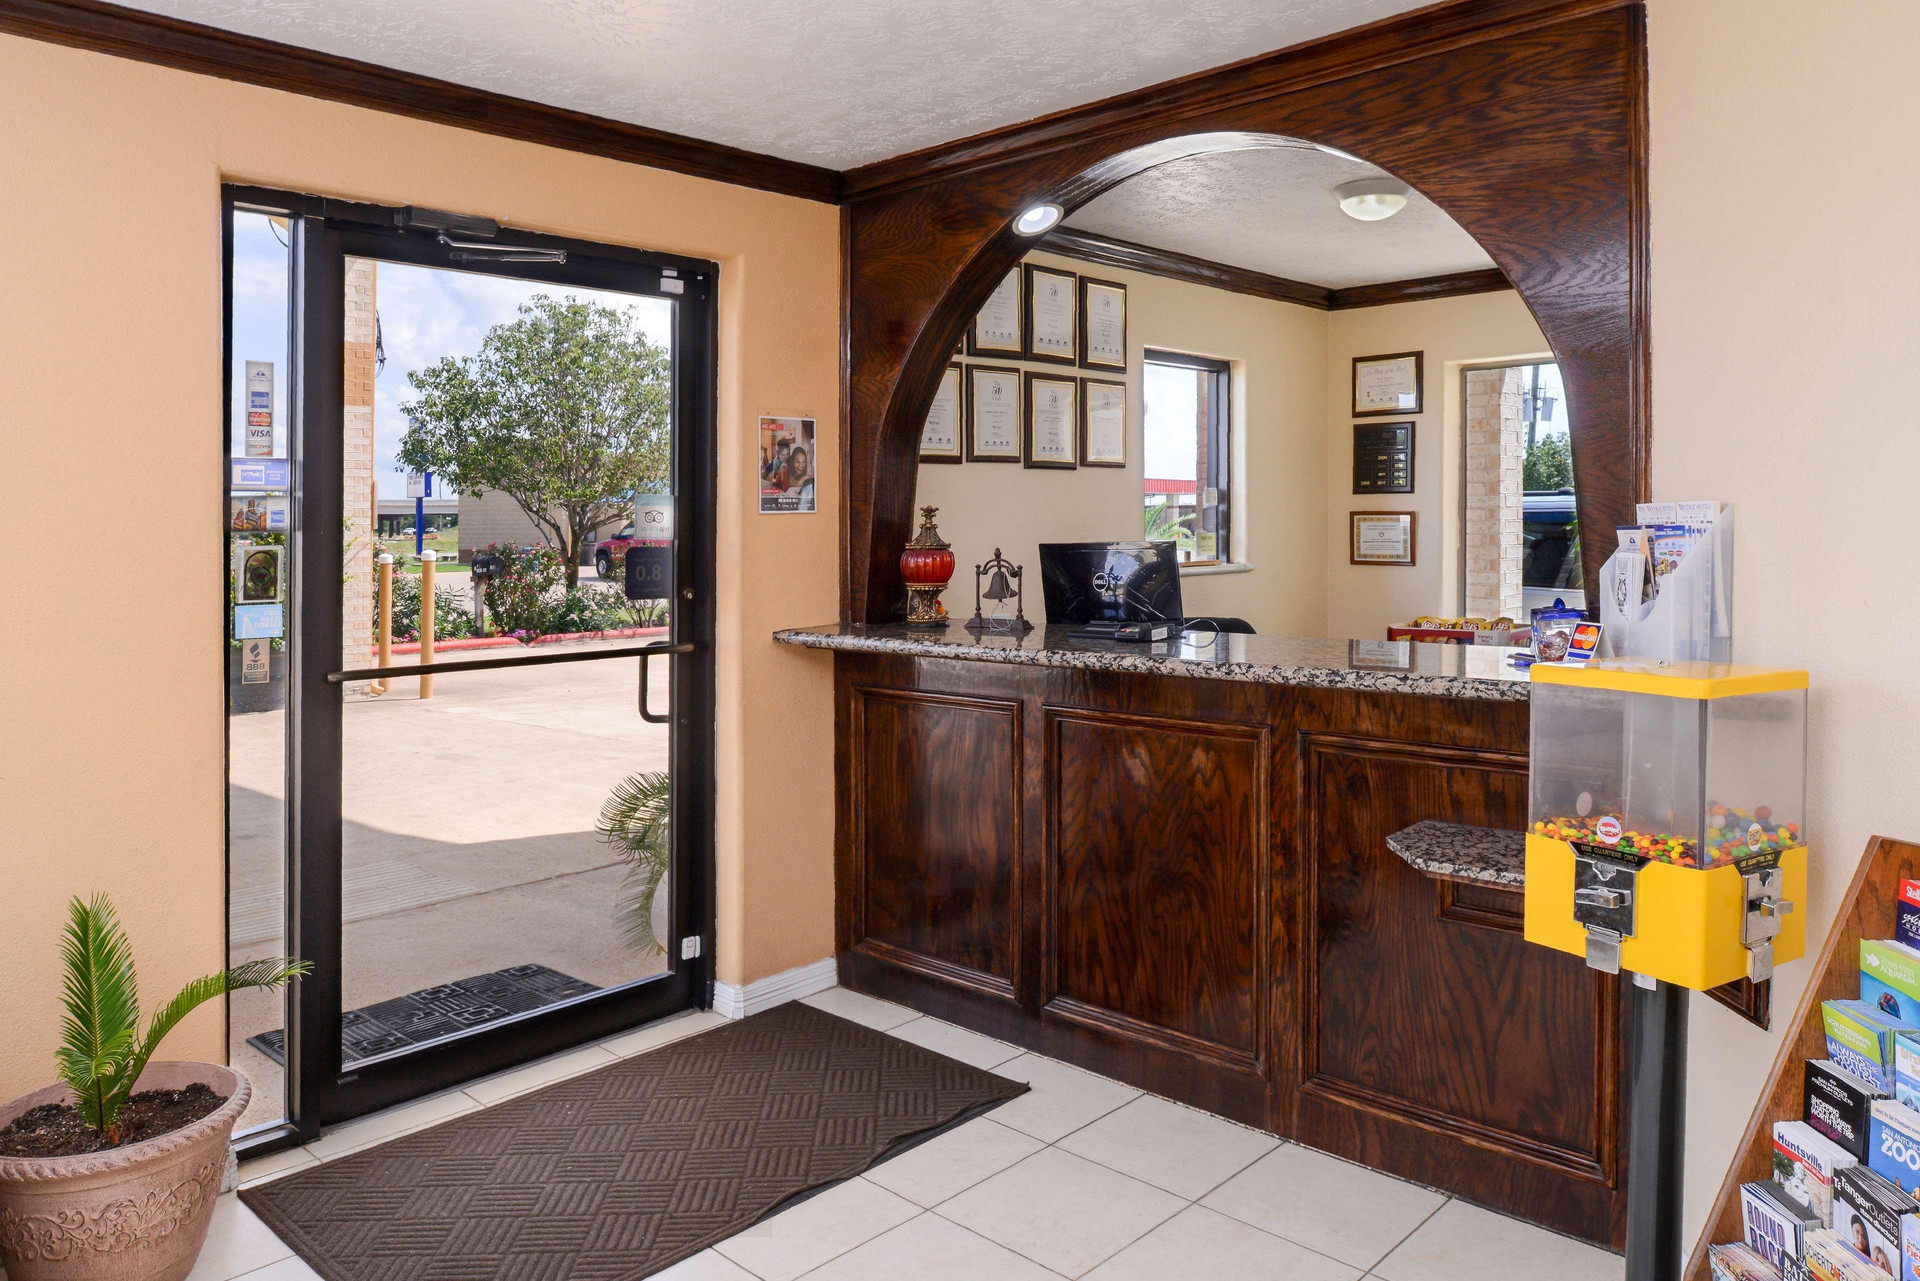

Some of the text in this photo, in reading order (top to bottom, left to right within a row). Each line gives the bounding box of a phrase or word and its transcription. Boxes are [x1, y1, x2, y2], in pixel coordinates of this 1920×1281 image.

[250, 429, 272, 438] VISA
[1581, 844, 1592, 852] USE
[1593, 847, 1622, 859] QUARTERS
[1623, 853, 1639, 863] ONLY
[1831, 1042, 1865, 1067] ALWAYS
[1811, 1094, 1840, 1117] SHOPPING
[1881, 1125, 1894, 1138] SAN
[1777, 1131, 1823, 1172] Huntsville
[1881, 1133, 1920, 1171] ZOO
[1746, 1199, 1787, 1249] ROUND
[1860, 1207, 1898, 1246] store directory
[1804, 1240, 1835, 1278] SCHERTZ
